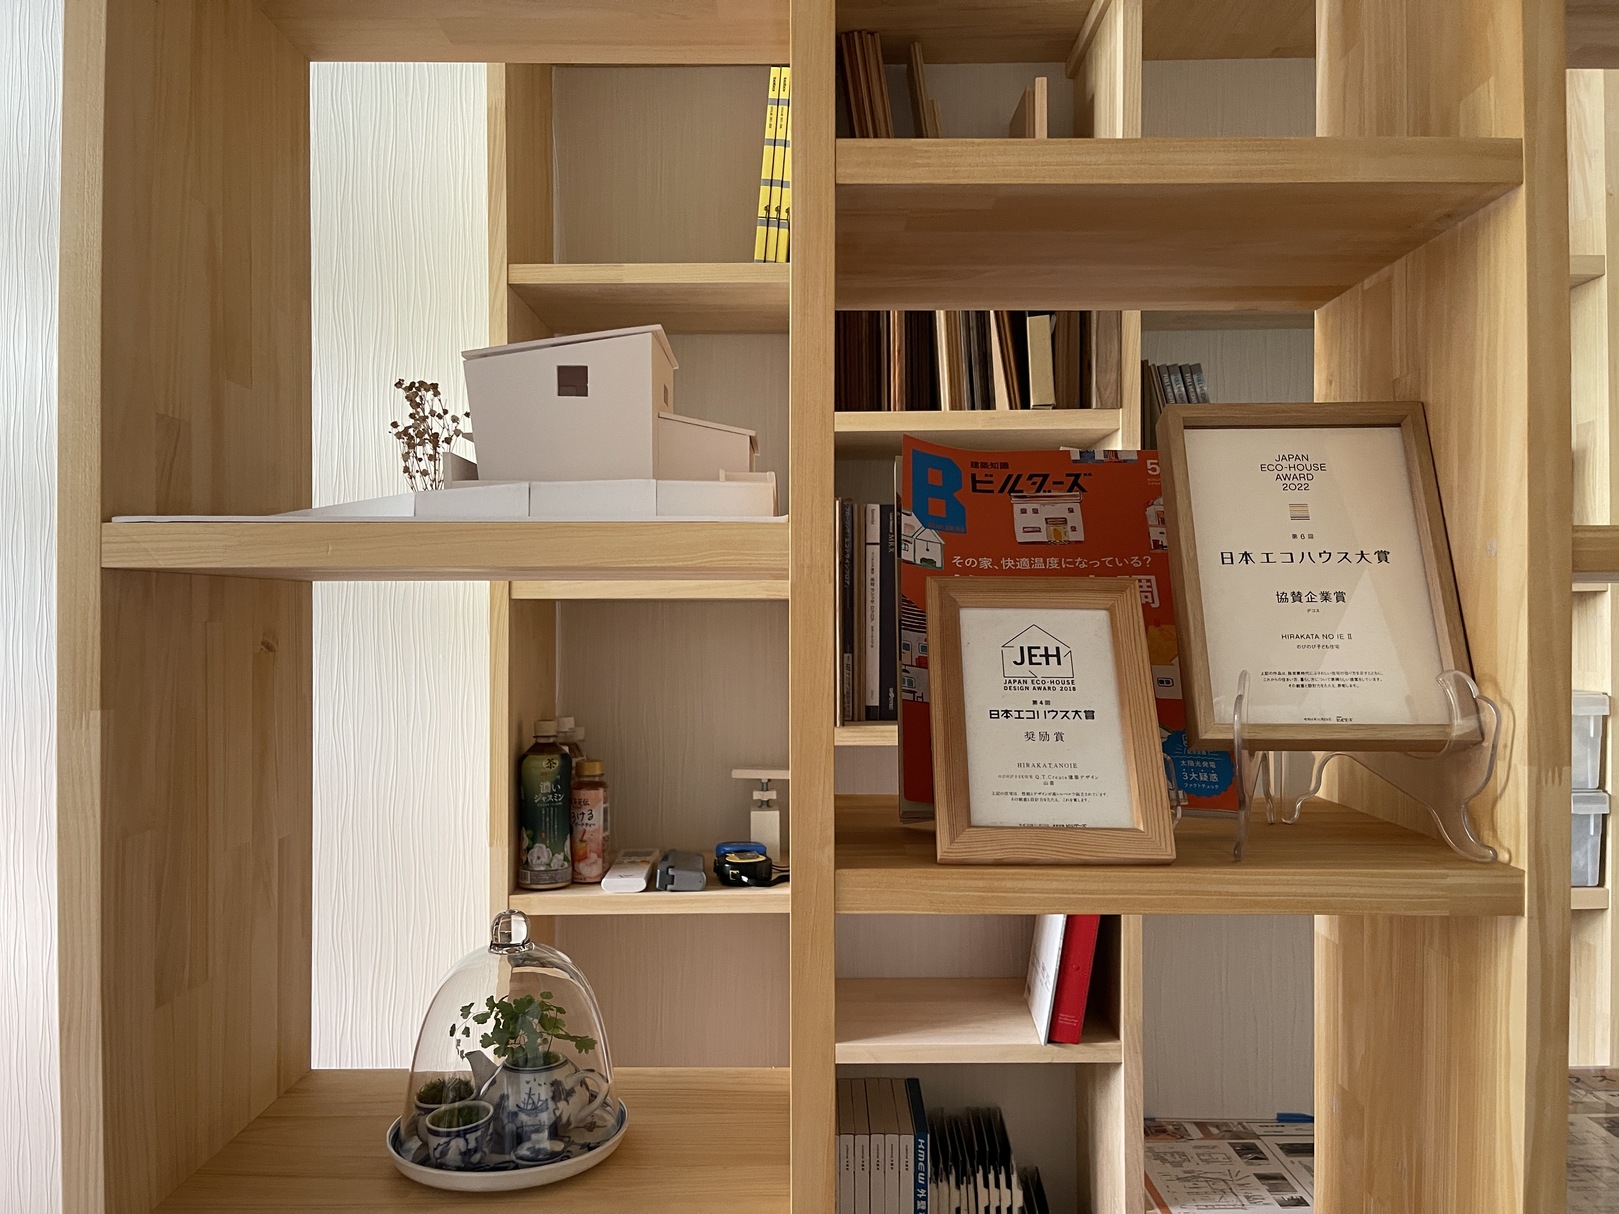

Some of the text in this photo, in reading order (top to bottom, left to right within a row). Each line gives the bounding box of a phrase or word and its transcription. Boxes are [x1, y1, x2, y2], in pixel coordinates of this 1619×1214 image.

[1274, 453, 1309, 462] JAPAN
[970, 461, 1010, 470] 建築知識
[1259, 463, 1327, 472] ECO-HOUSE
[970, 472, 1093, 494] ビルダーズ
[1275, 473, 1314, 482] AWARD
[1282, 482, 1310, 491] 2022
[1220, 550, 1391, 565] 日本エコハウス大賞
[1275, 590, 1347, 603] 協賛企業賞
[1012, 645, 1062, 666] JEH
[989, 709, 1096, 720] 日本エコハウス大賞
[1024, 730, 1065, 742] 奨励賞
[545, 758, 557, 770] 茶
